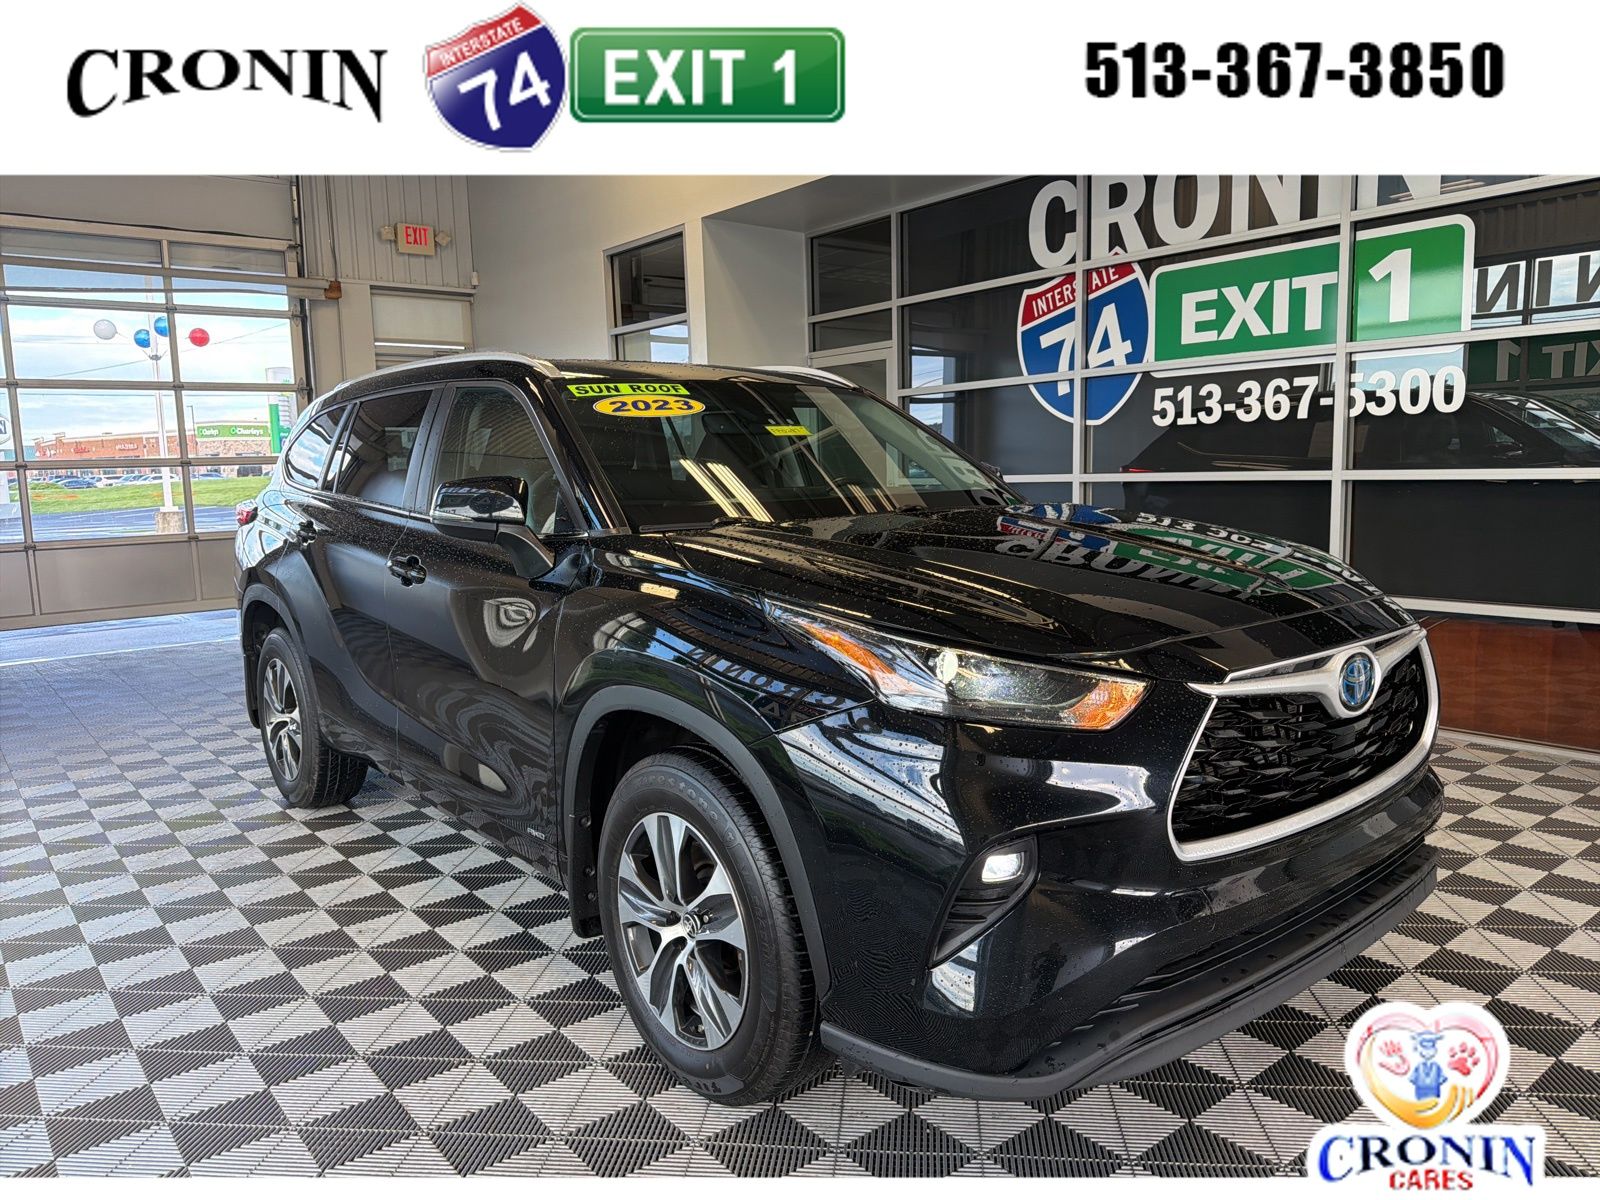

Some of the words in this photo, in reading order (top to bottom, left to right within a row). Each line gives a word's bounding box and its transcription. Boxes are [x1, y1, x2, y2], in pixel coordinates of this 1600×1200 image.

[405, 225, 429, 247] EXIT
[1032, 266, 1120, 318] INTERATE
[1180, 271, 1338, 346] EXIT
[1367, 247, 1412, 323] 1
[1039, 302, 1133, 397] 74
[575, 384, 621, 395] SUN
[628, 383, 683, 394] ROOF
[609, 399, 695, 413] 2023
[1151, 365, 1467, 428] 513-367-5300
